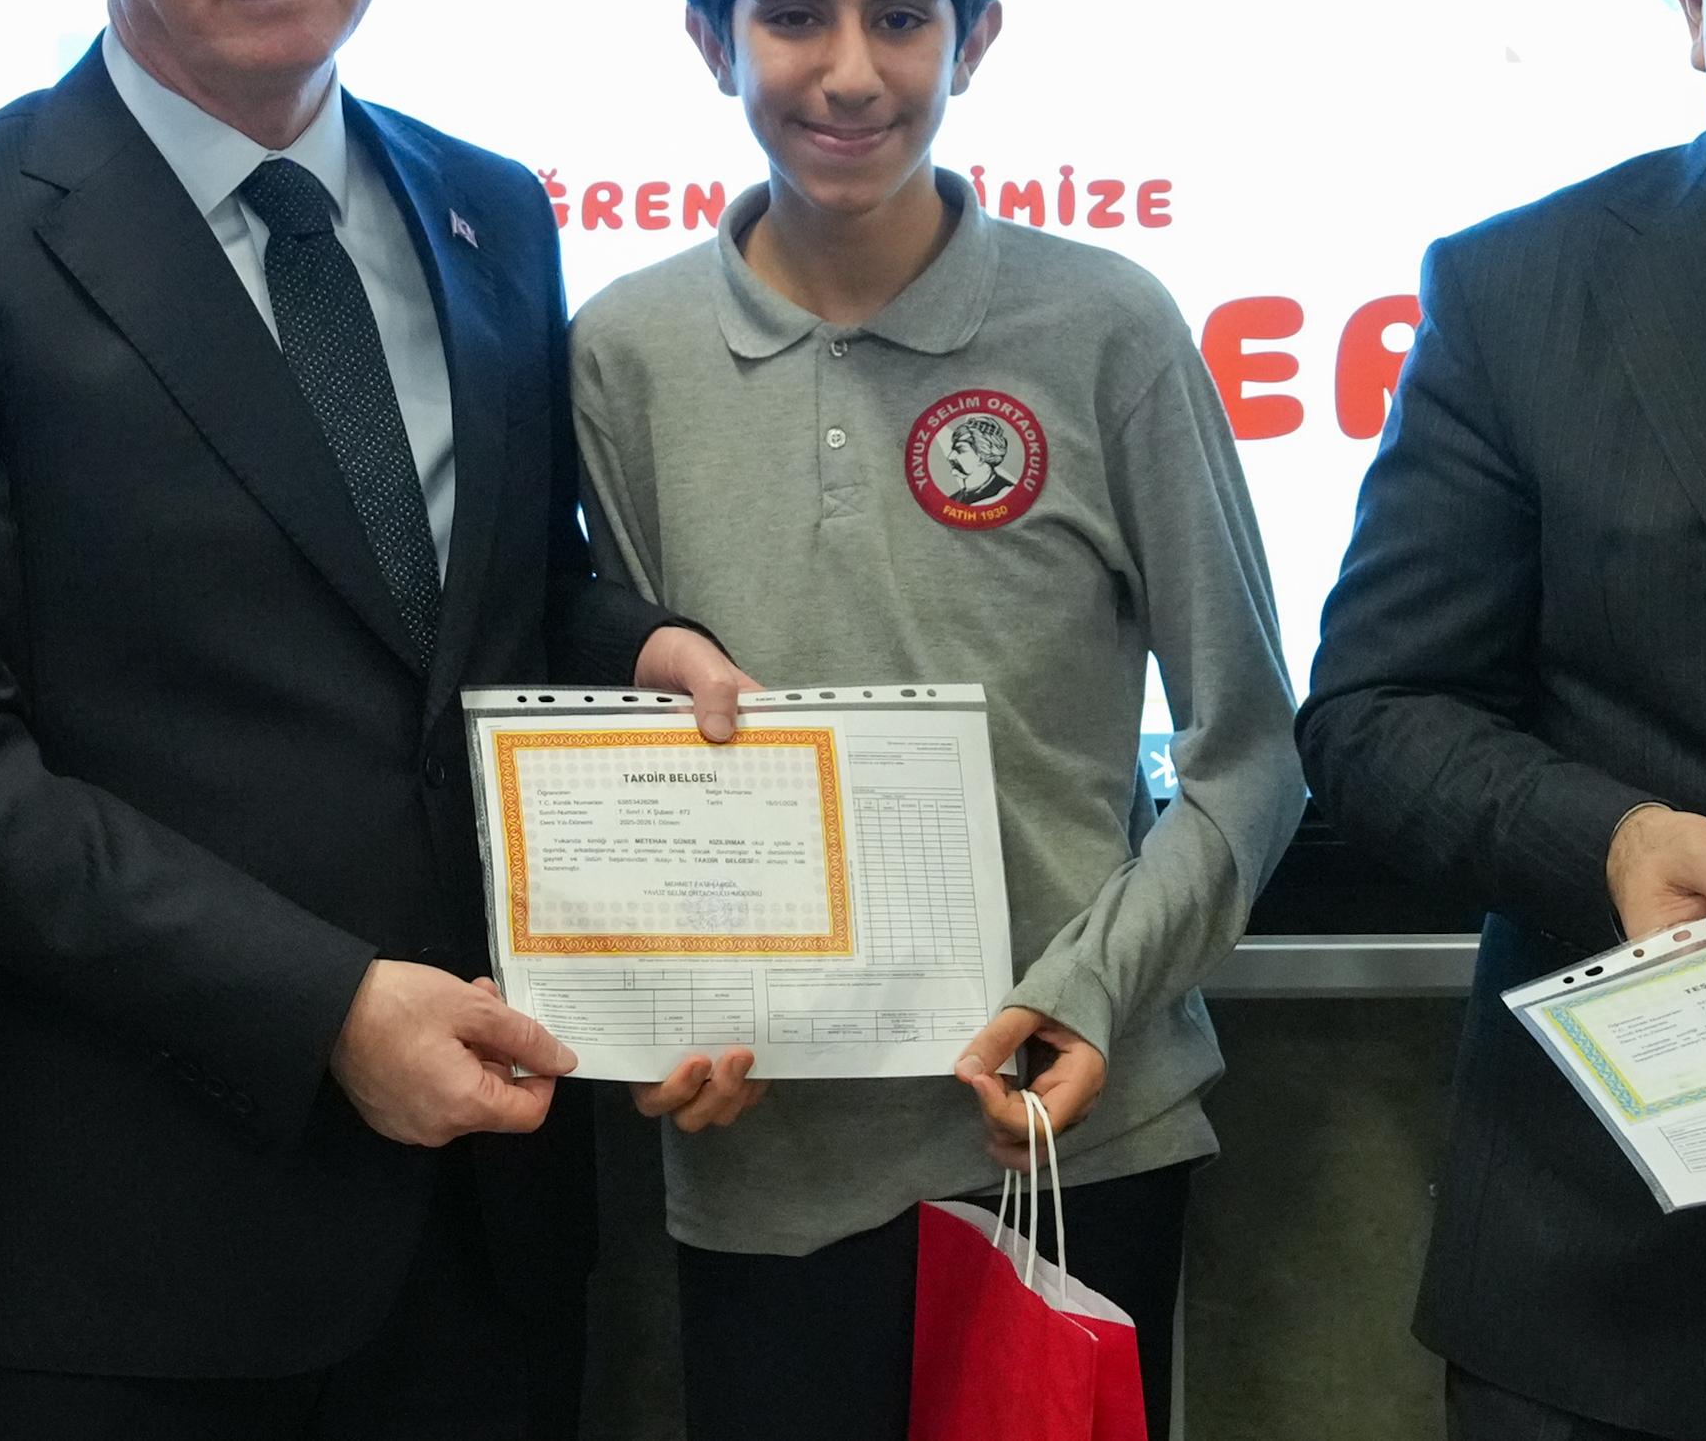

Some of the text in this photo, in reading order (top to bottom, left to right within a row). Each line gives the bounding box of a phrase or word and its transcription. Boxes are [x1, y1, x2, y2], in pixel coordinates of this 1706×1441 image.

[912, 396, 1041, 491] YAVUZ SELİM ORTAOKULU
[943, 505, 1008, 521] FATİH 1930
[623, 771, 717, 783] TAKDİR BELGESİ
